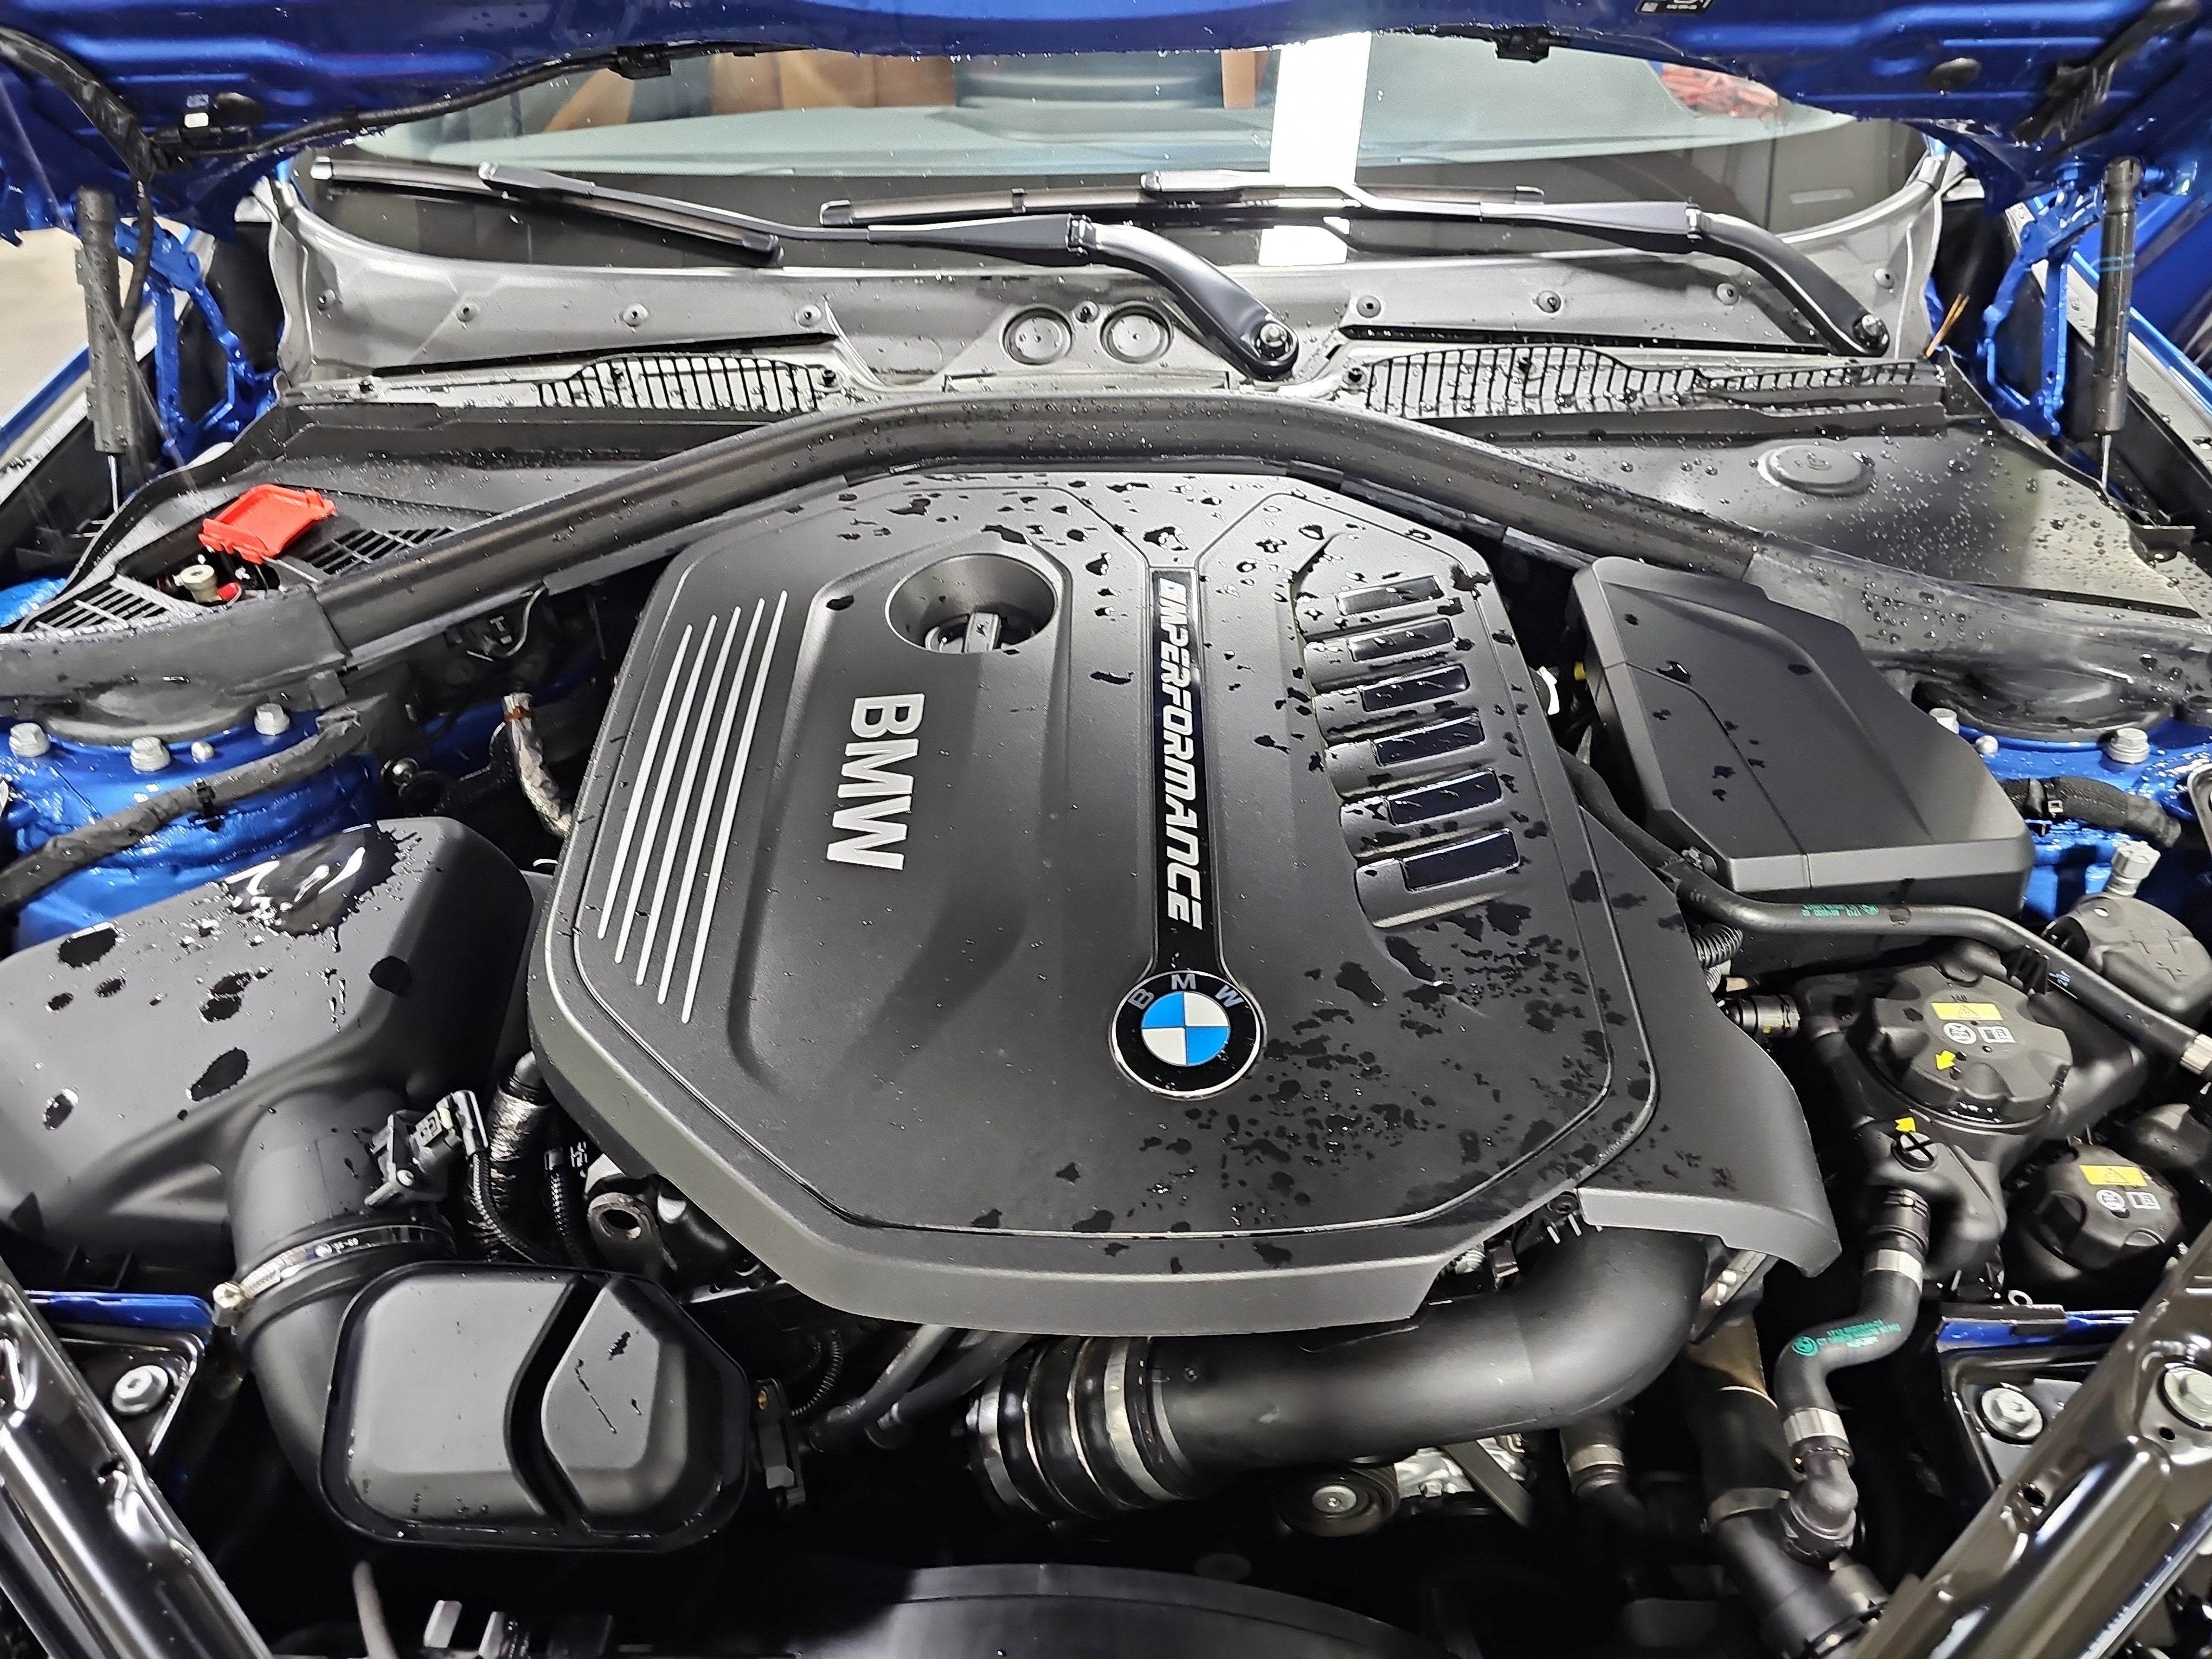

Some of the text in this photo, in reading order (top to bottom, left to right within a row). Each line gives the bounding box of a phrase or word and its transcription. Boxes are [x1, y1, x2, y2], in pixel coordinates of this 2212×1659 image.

[826, 693, 925, 870] BMW
[1161, 623, 1203, 930] PERFORMANCE
[1128, 974, 1244, 1009] BMW
